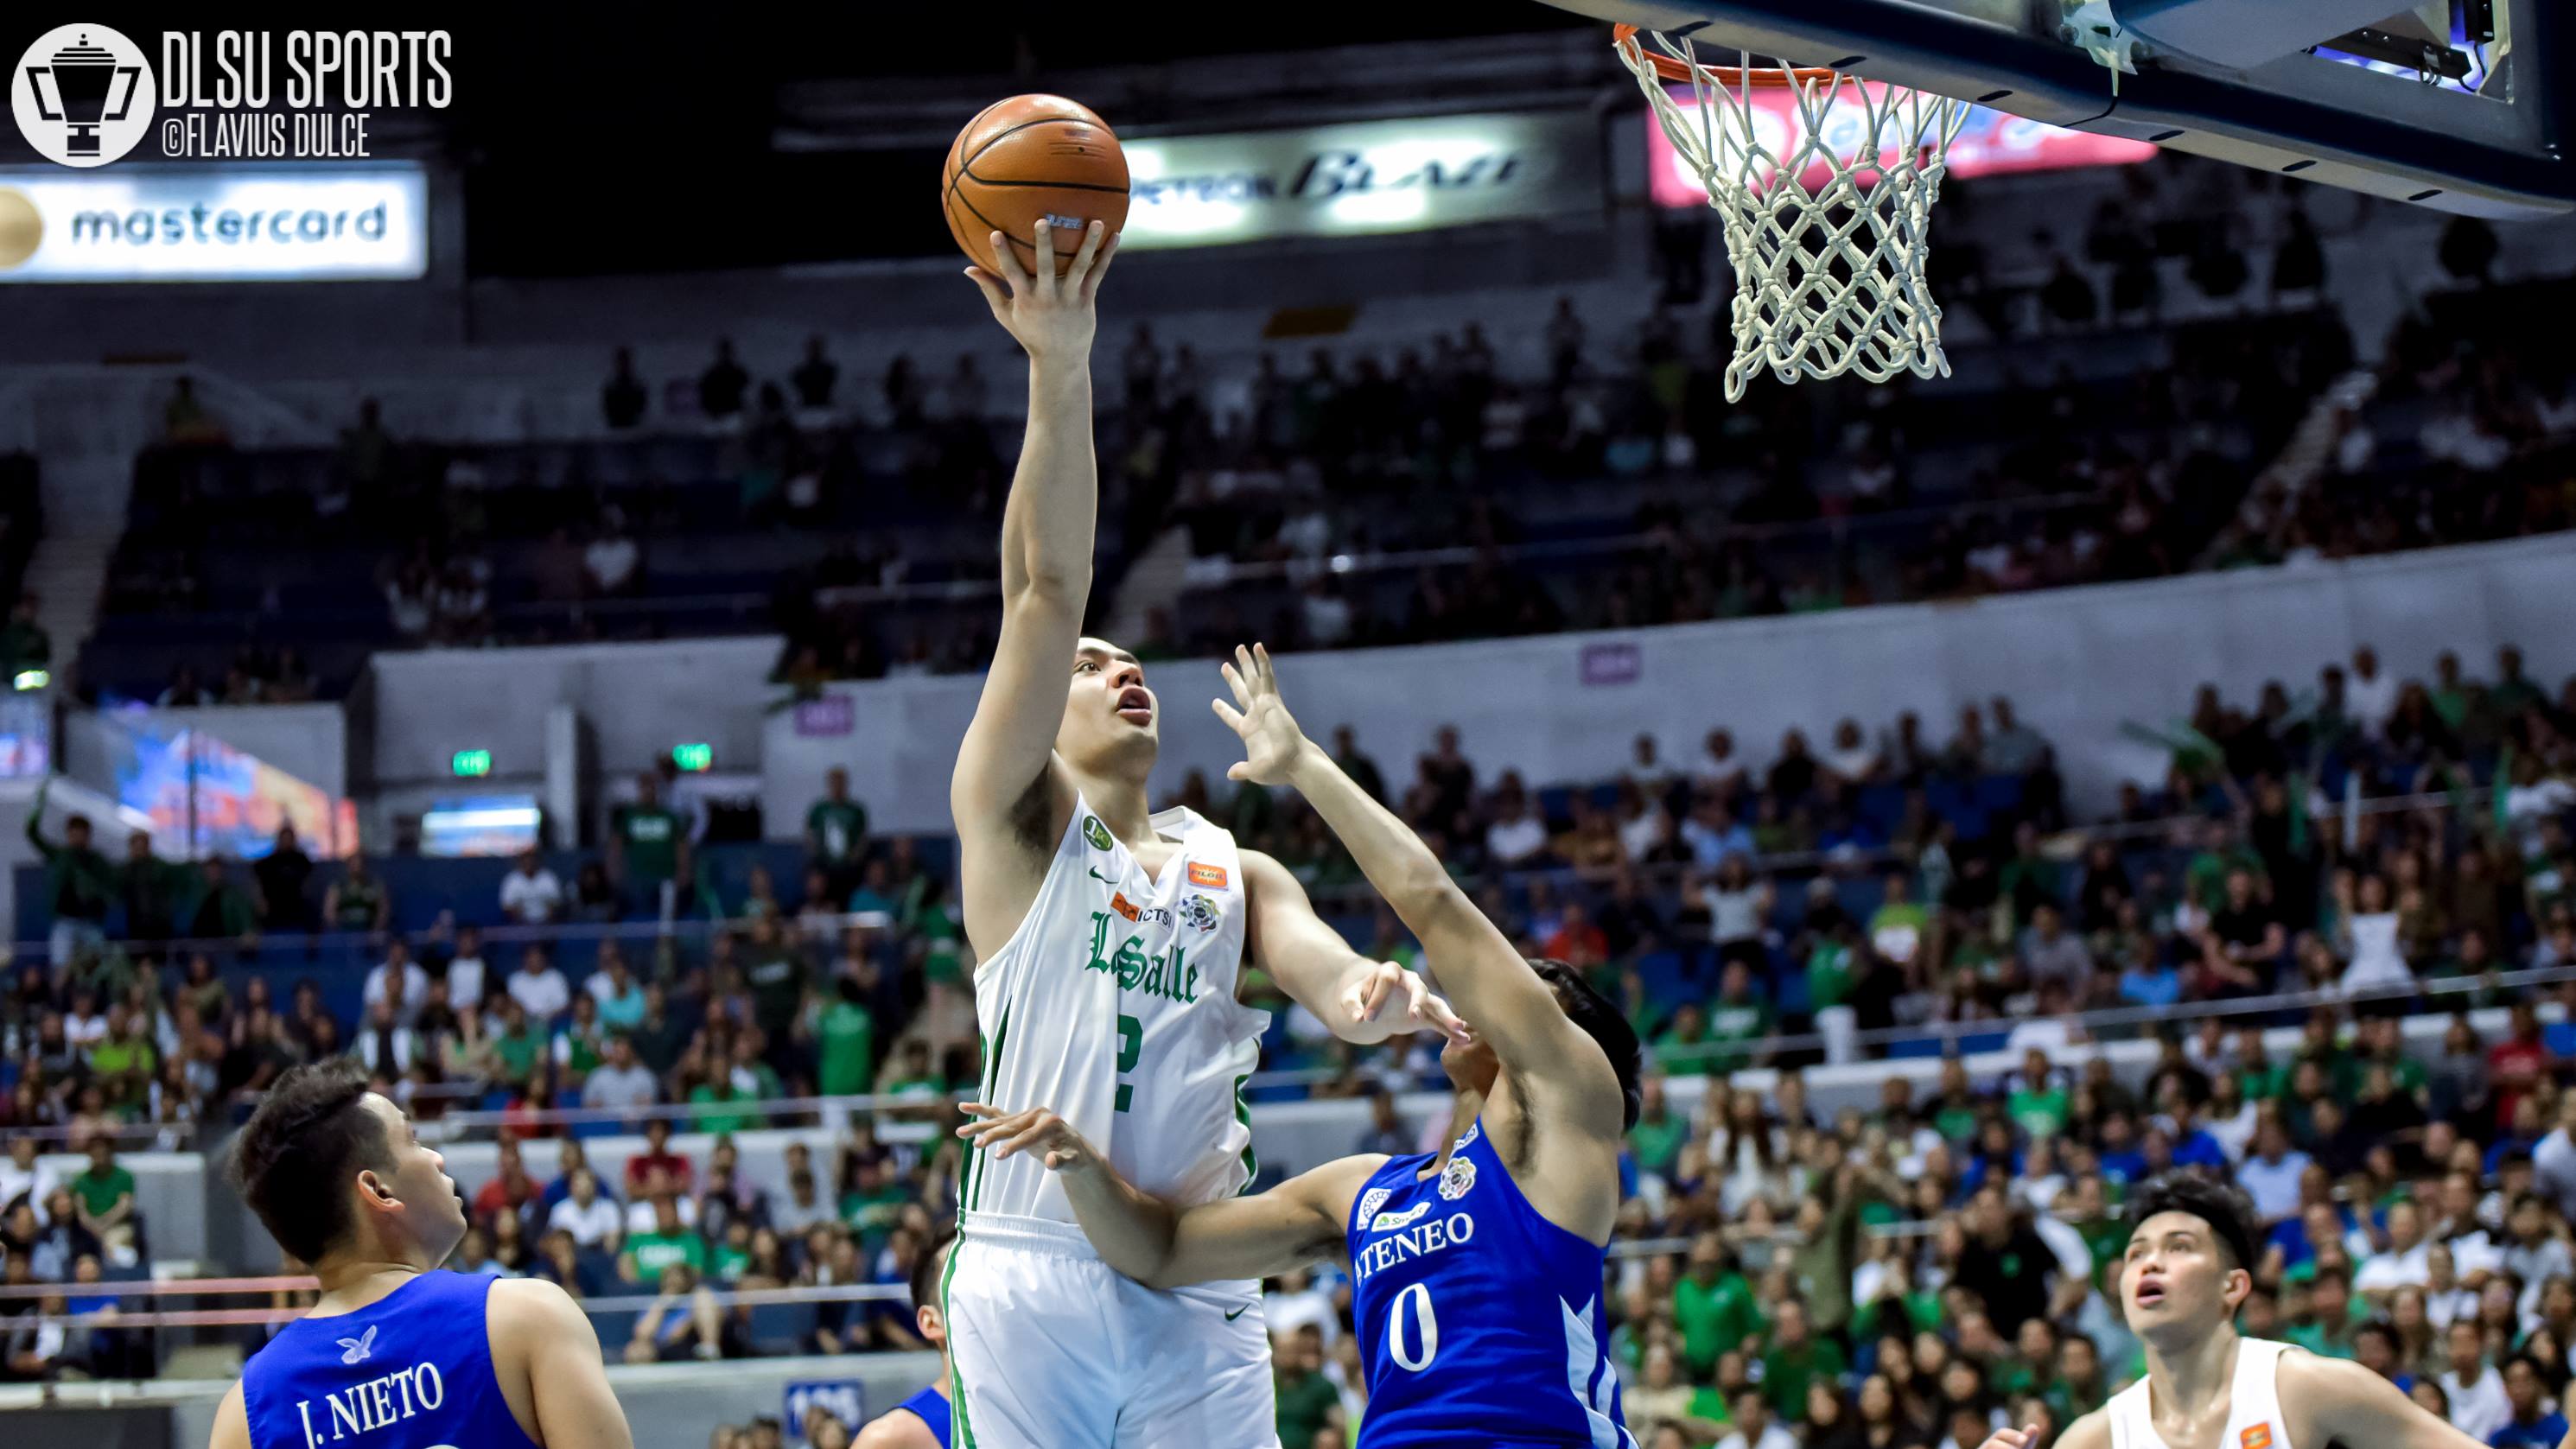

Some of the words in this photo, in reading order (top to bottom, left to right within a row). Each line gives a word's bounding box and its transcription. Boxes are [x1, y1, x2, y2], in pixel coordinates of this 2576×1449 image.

[72, 200, 388, 245] mastercard
[1137, 908, 1172, 928] ICTSI
[1114, 1014, 1143, 1113] 2
[1389, 1282, 1438, 1372] 0
[296, 1400, 324, 1449] J.
[325, 1361, 443, 1440] NIETO
